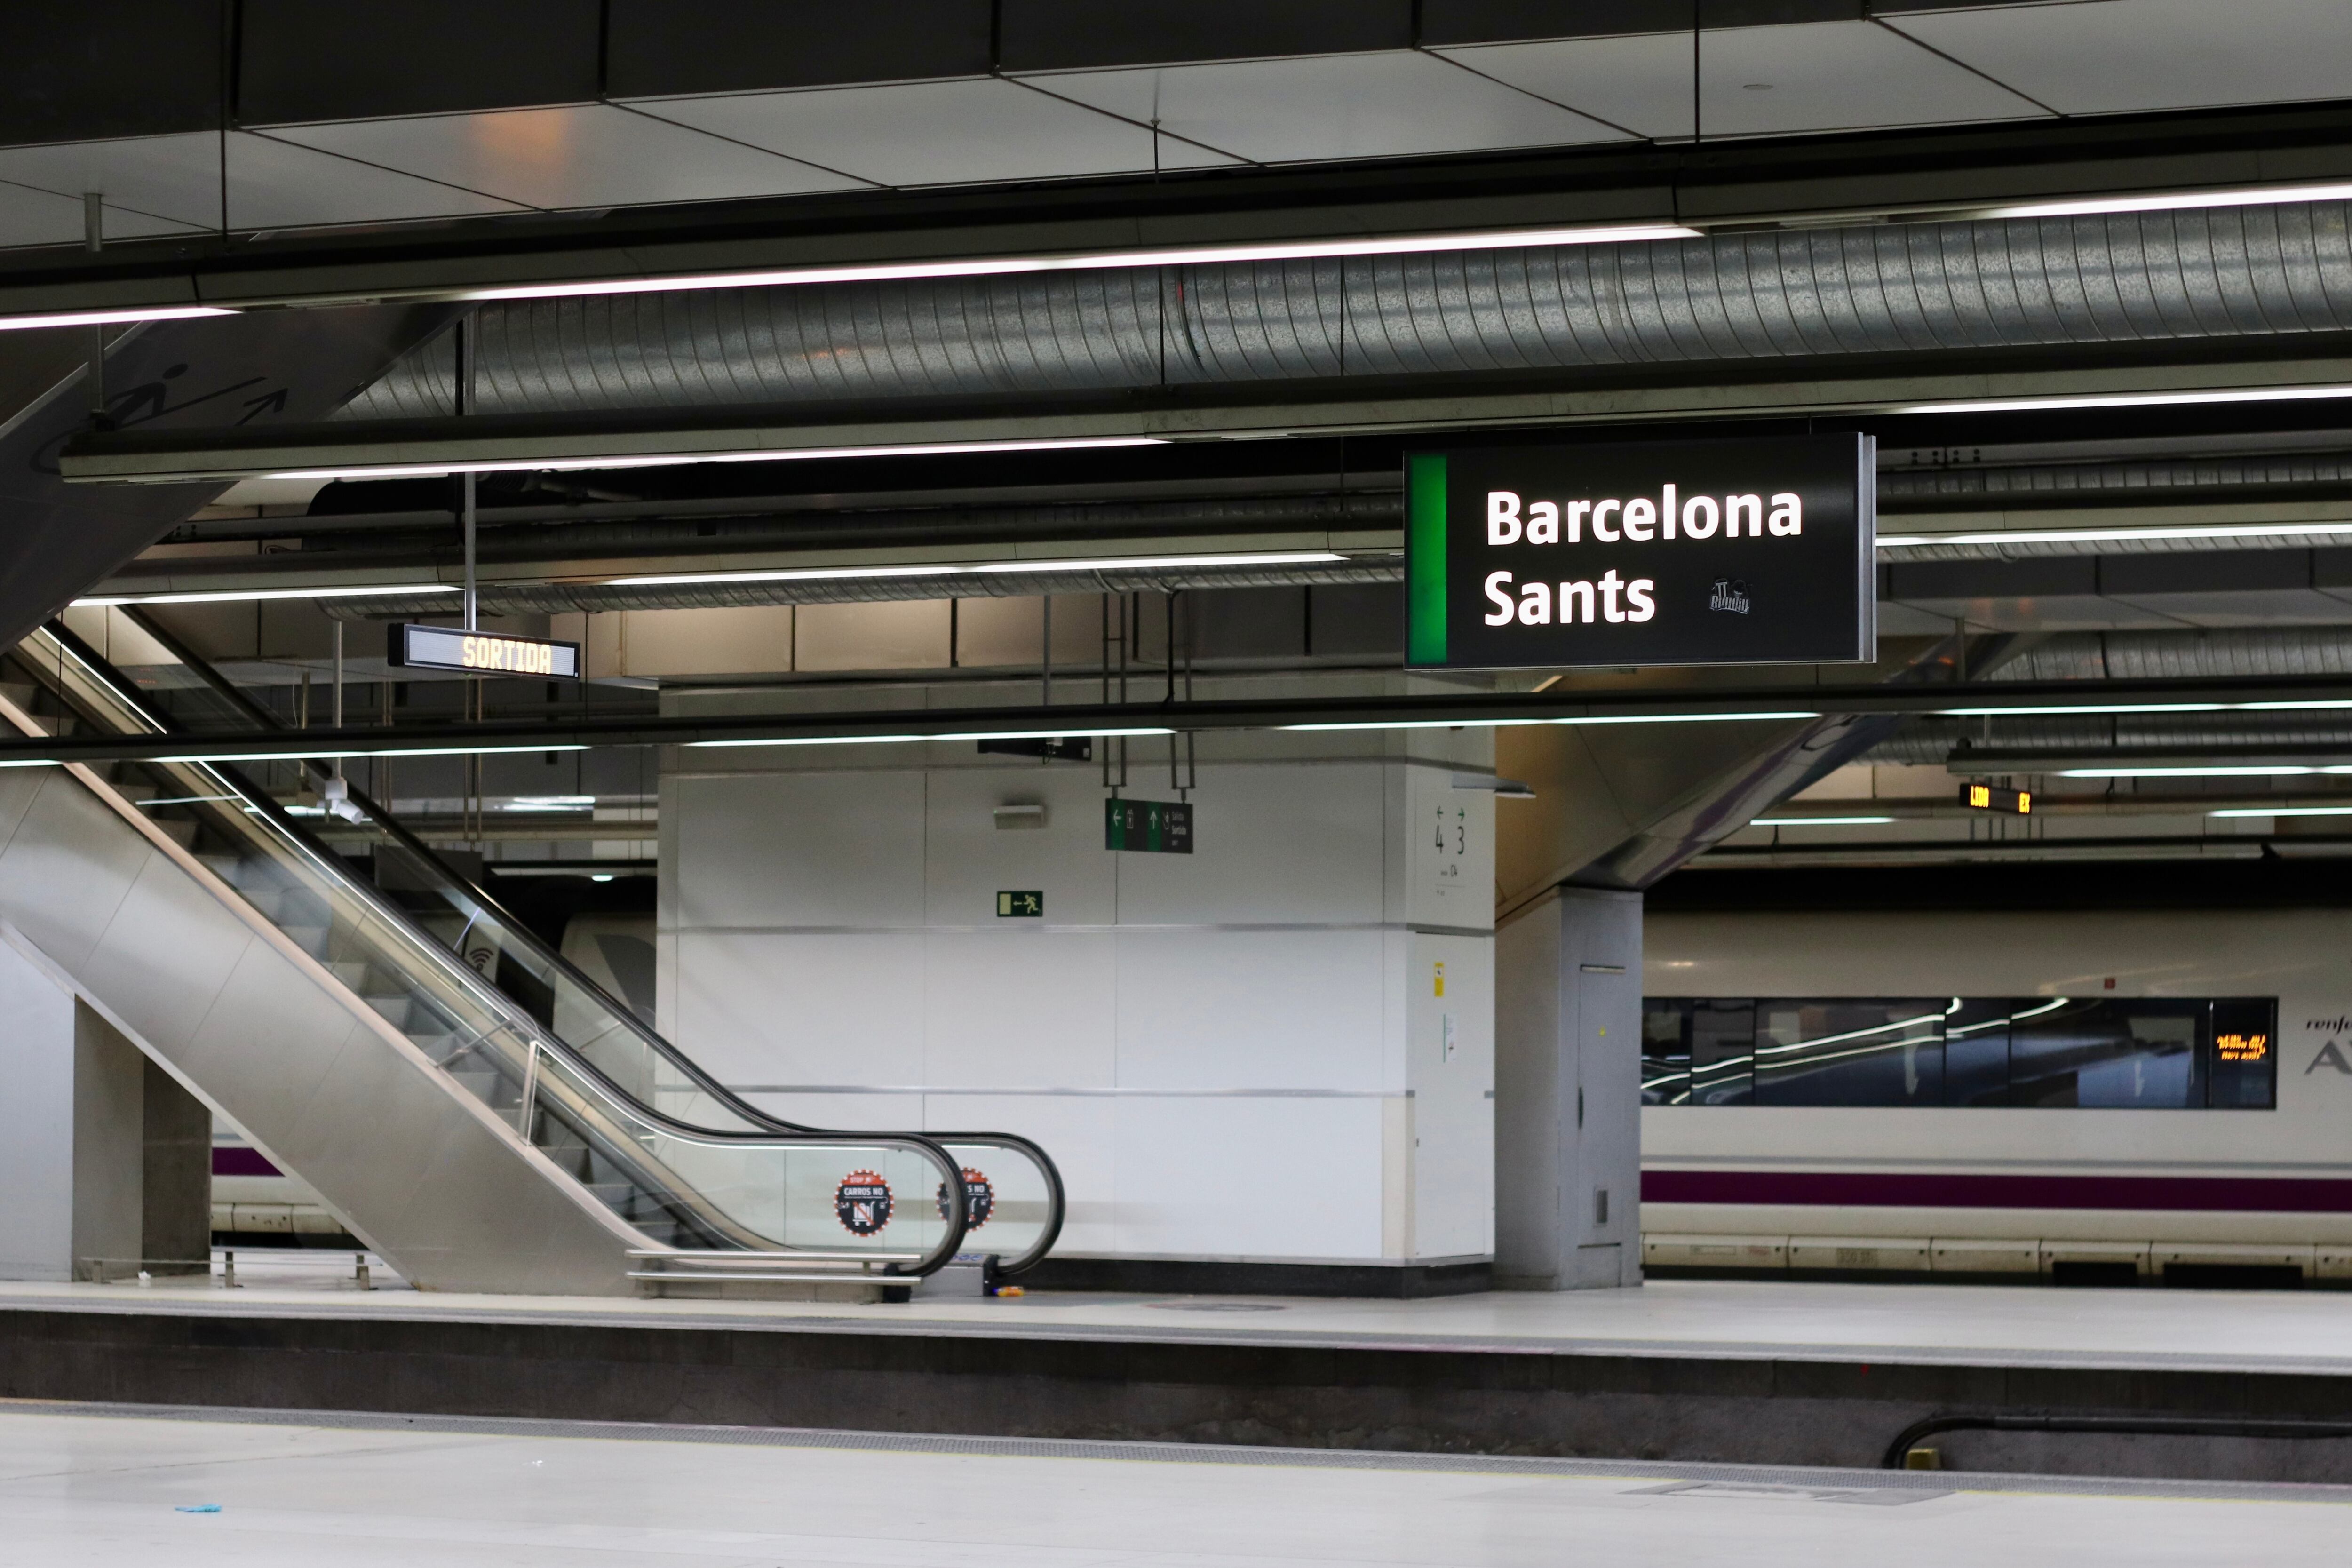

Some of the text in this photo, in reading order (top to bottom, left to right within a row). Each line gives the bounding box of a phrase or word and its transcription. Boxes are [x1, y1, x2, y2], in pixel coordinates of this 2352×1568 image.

[1487, 484, 1802, 546] Barcelona
[1484, 569, 1655, 627] Sants
[463, 636, 551, 674] SORTIDA
[1970, 785, 1989, 808] LIDA
[1435, 825, 1464, 854] 4 3
[2304, 1039, 2352, 1075] A
[844, 1187, 884, 1196] CARROS NO
